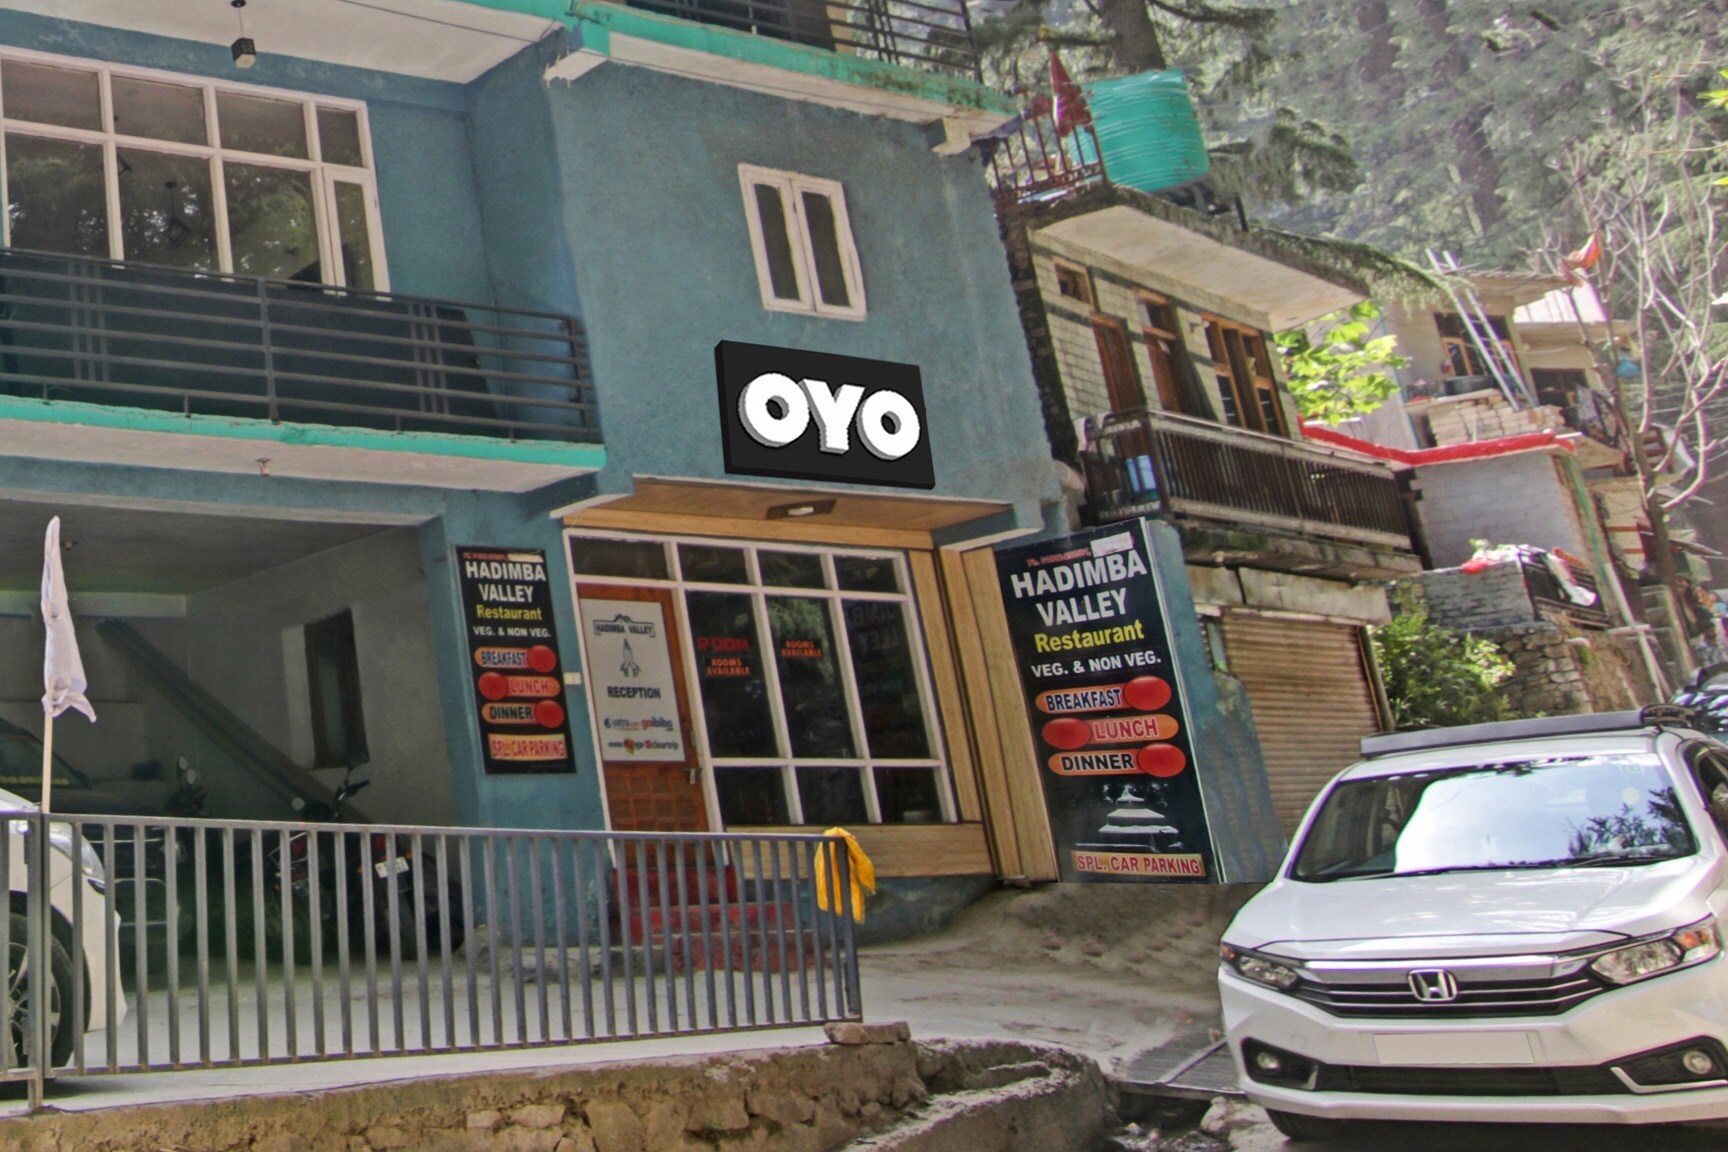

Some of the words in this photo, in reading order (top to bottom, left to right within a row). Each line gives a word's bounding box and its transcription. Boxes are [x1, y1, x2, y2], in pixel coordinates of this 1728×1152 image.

[738, 372, 921, 460] OYO
[465, 561, 547, 581] HADIMBA
[1010, 550, 1148, 599] HADIMBA
[478, 583, 534, 603] VALLEY
[475, 604, 543, 620] Restaurant
[1035, 588, 1127, 627] VALLEY
[472, 626, 495, 636] VEG.
[498, 627, 505, 636] &
[507, 627, 528, 637] NON
[529, 628, 551, 638] VEG.
[1034, 618, 1145, 653] Restaurant
[481, 651, 527, 665] BREAKFAST
[781, 649, 823, 657] AVAILABLE
[706, 666, 751, 676] AVAILABLE
[1031, 662, 1069, 678] VEG.
[1073, 660, 1085, 674] &
[1088, 655, 1122, 672] NON
[1124, 650, 1162, 667] VEG.
[511, 679, 549, 694] LUNCH
[607, 686, 661, 699] RECEPTION
[1045, 688, 1122, 711] BREAKFAST
[489, 706, 534, 720] DINNER
[1094, 717, 1159, 740] LUNCH
[1061, 753, 1136, 771] DINNER
[1076, 855, 1107, 871] SPL.
[1110, 856, 1139, 872] CAR
[1143, 857, 1201, 875] PARKING
